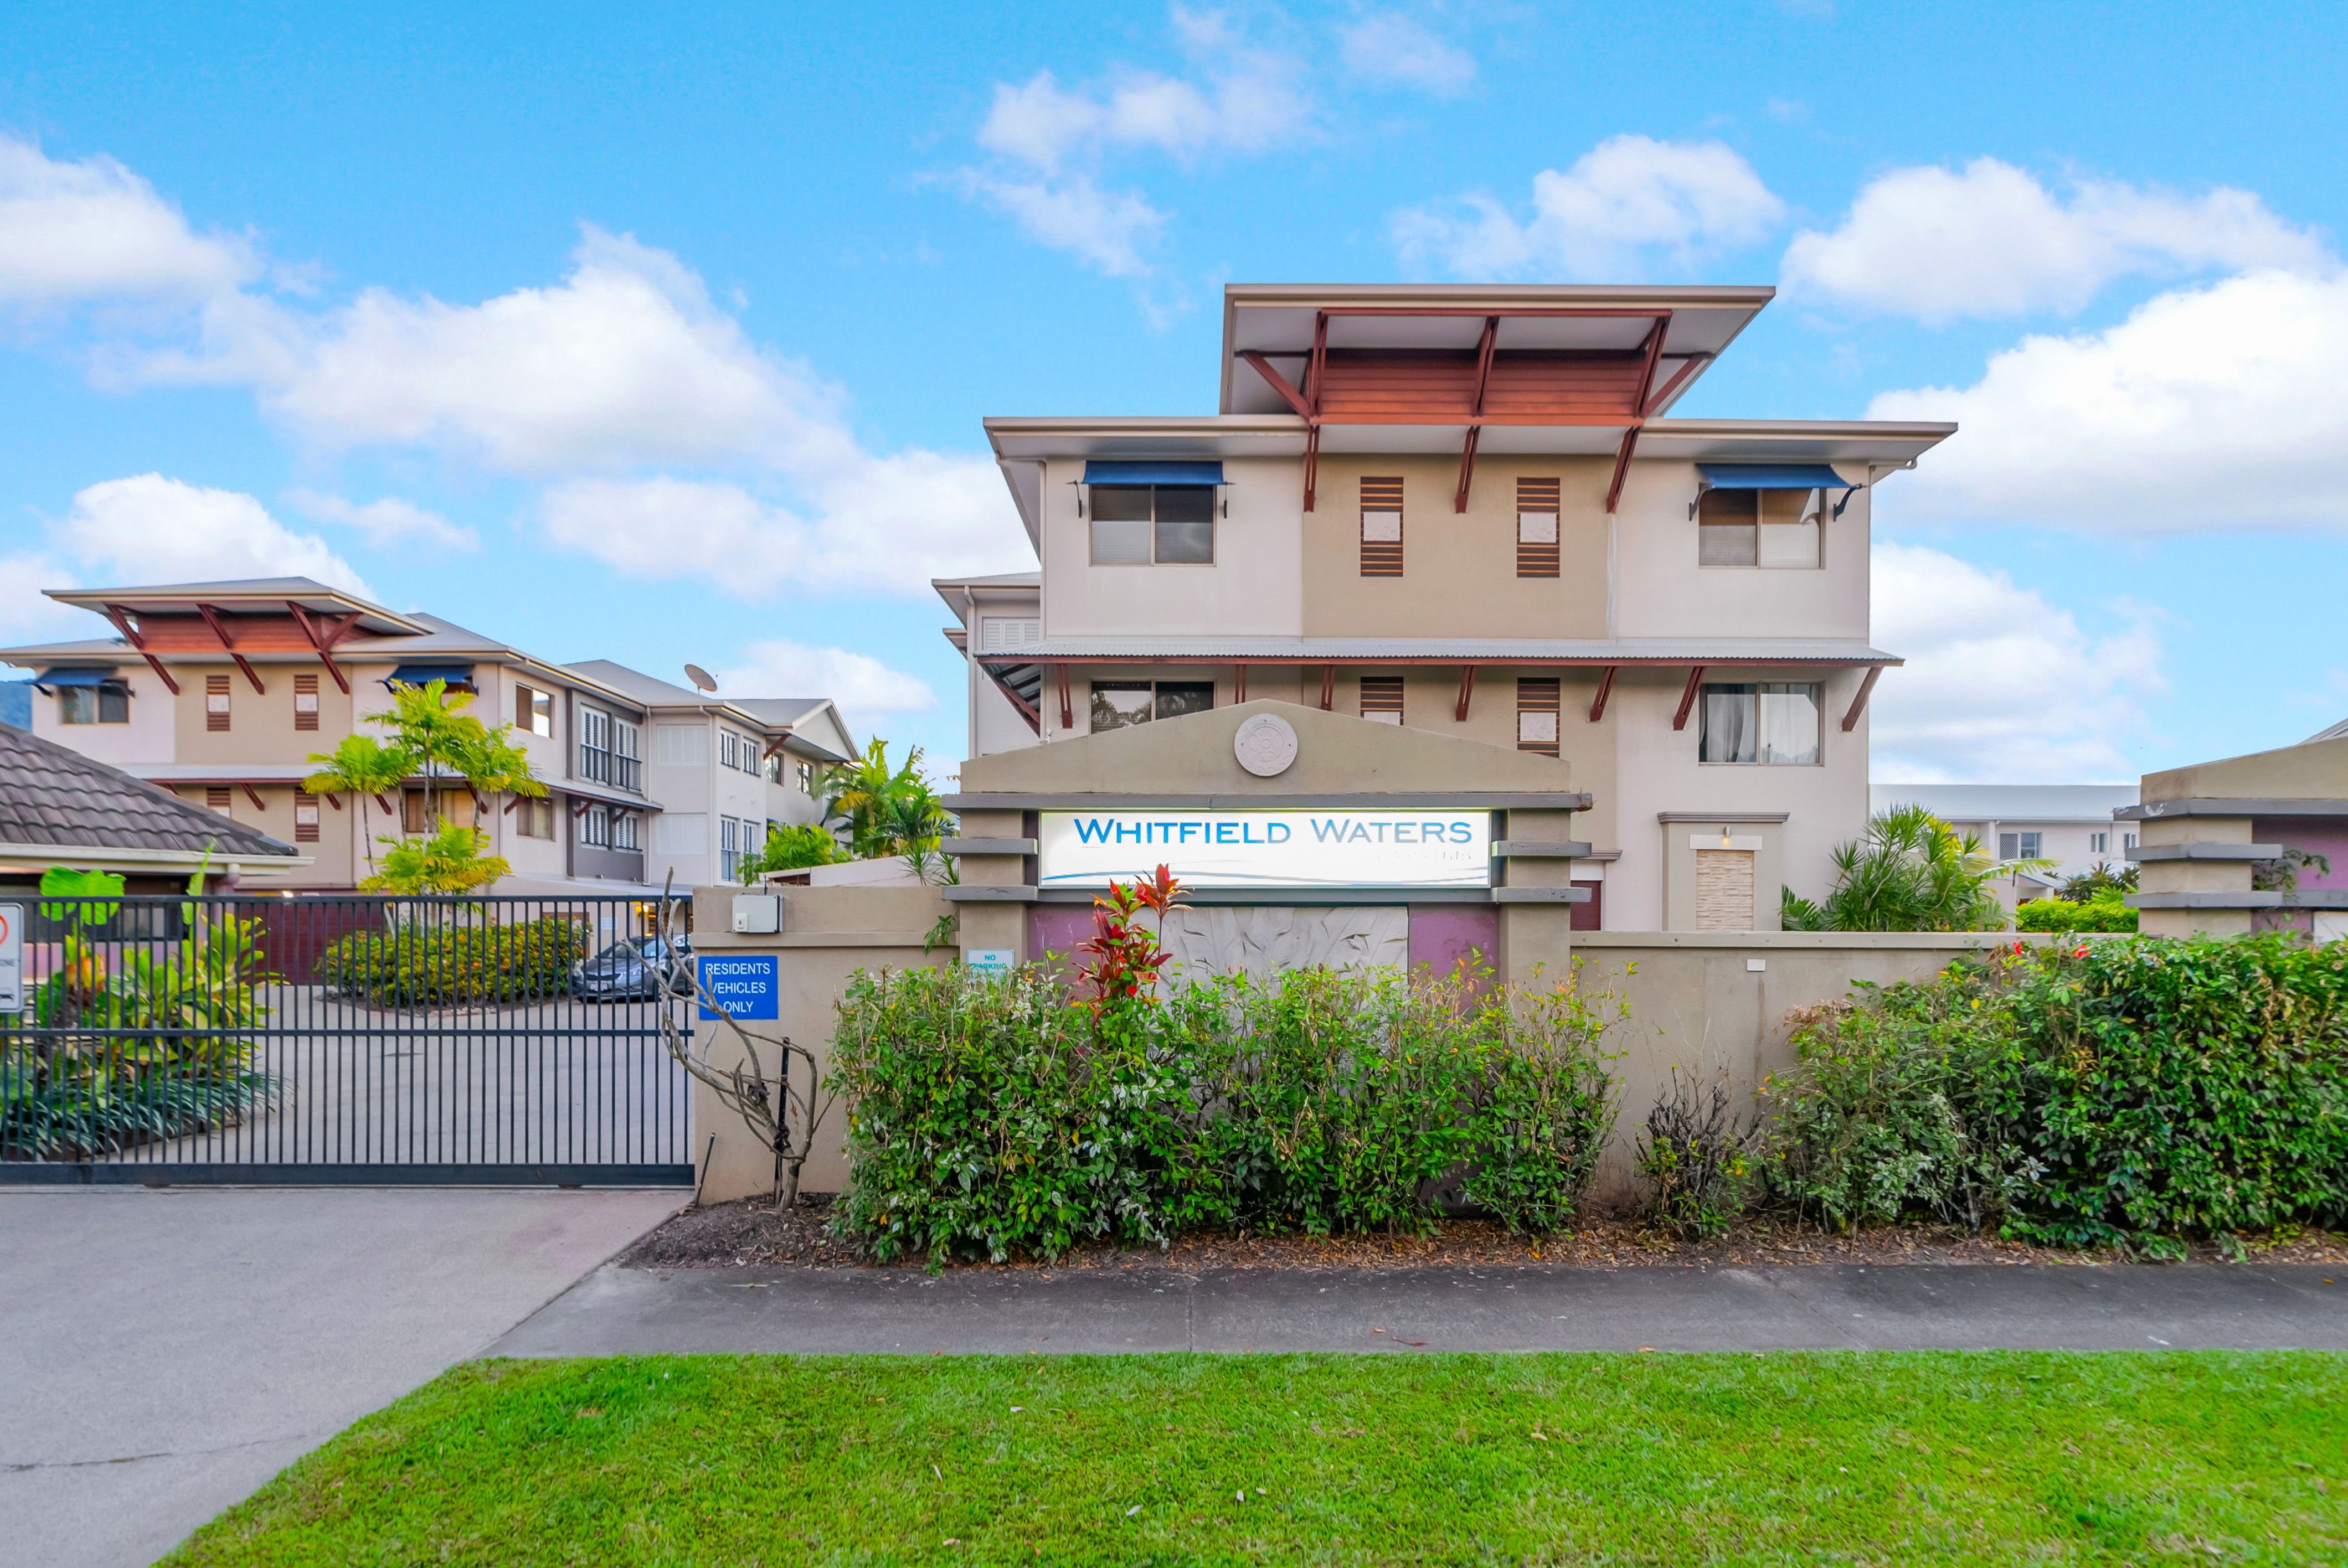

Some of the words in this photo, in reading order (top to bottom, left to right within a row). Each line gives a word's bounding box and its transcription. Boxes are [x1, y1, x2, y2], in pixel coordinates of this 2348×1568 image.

[1073, 818, 1291, 844] WHITFIELD
[1310, 818, 1472, 844] WATERS
[705, 963, 771, 975] RESIDENTS
[723, 1000, 754, 1013] ONLY
